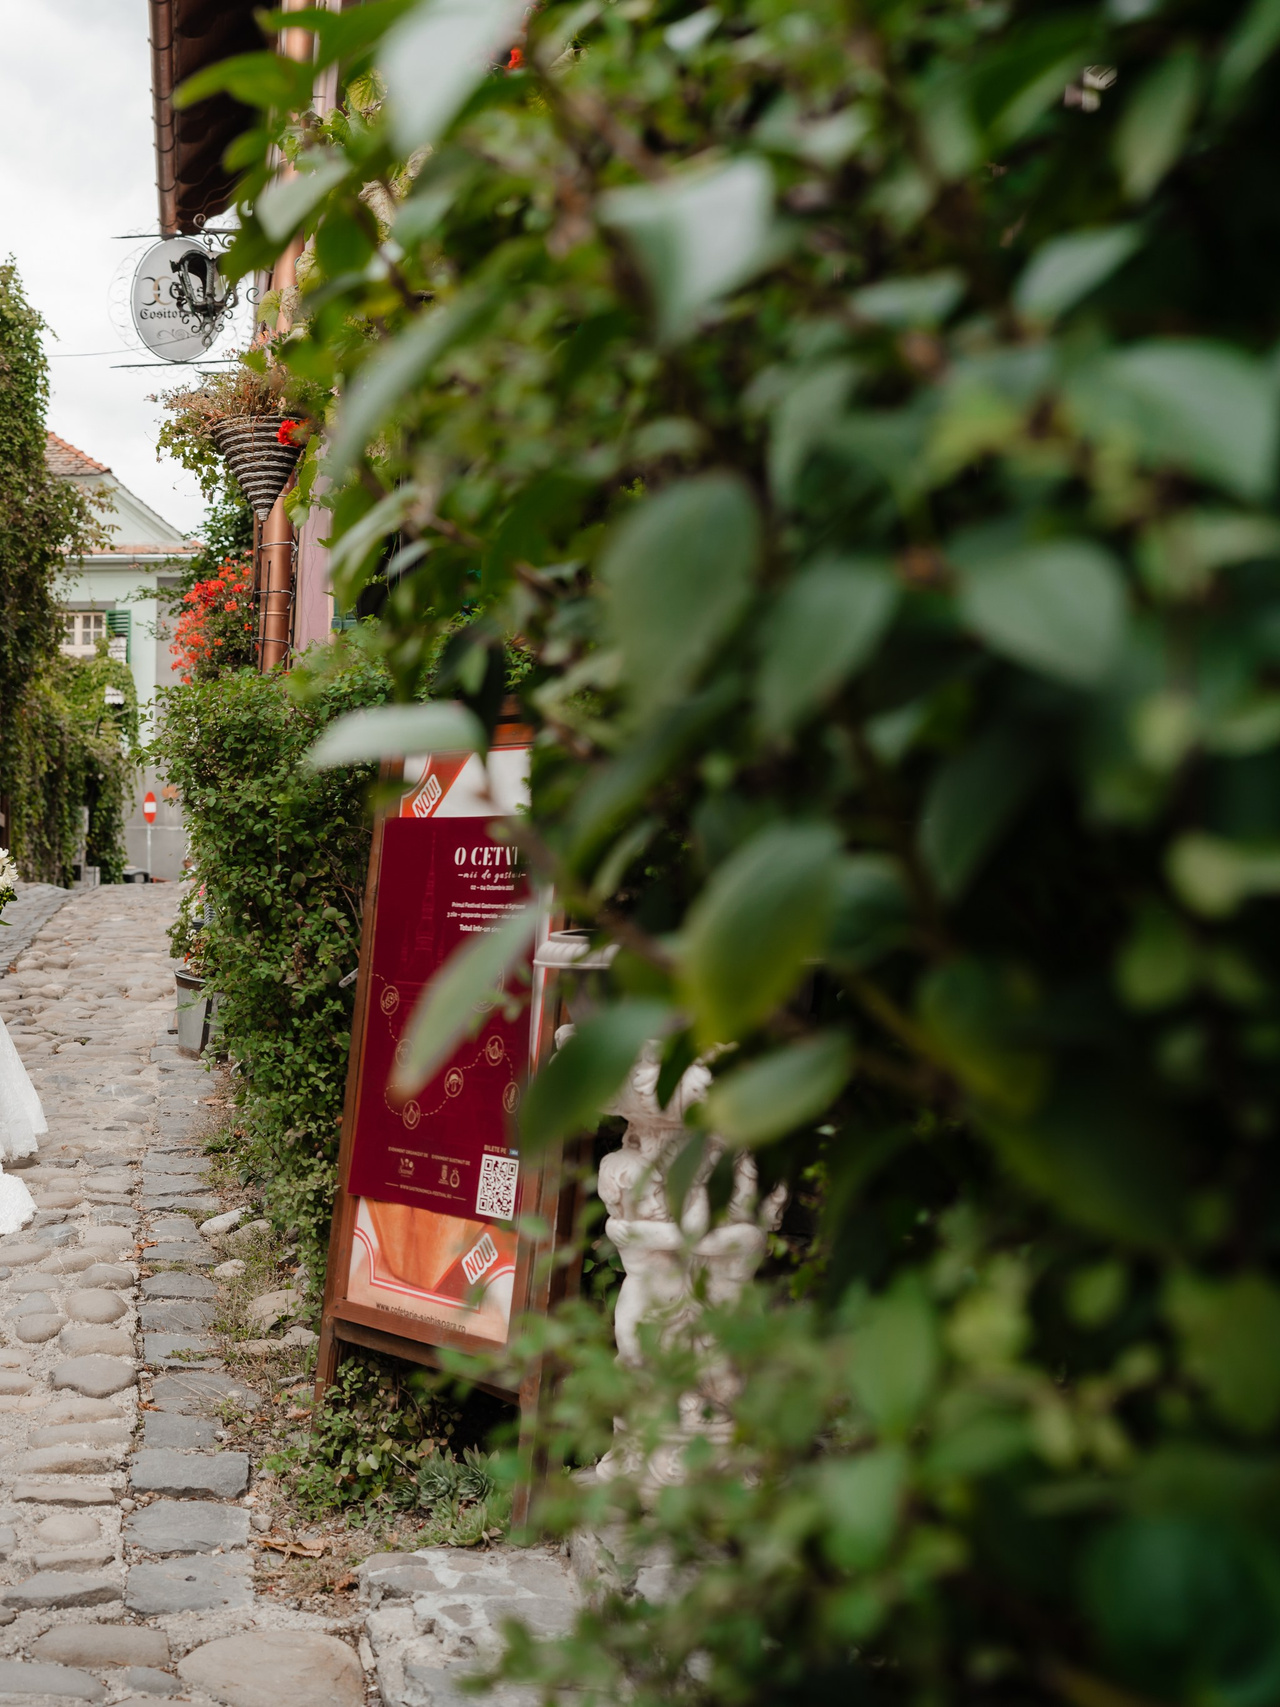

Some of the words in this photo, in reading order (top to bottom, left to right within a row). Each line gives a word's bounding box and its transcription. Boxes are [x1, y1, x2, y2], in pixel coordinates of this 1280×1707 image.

[412, 774, 442, 817] NOU!
[454, 846, 467, 866] O
[462, 1233, 498, 1285] NOU!
